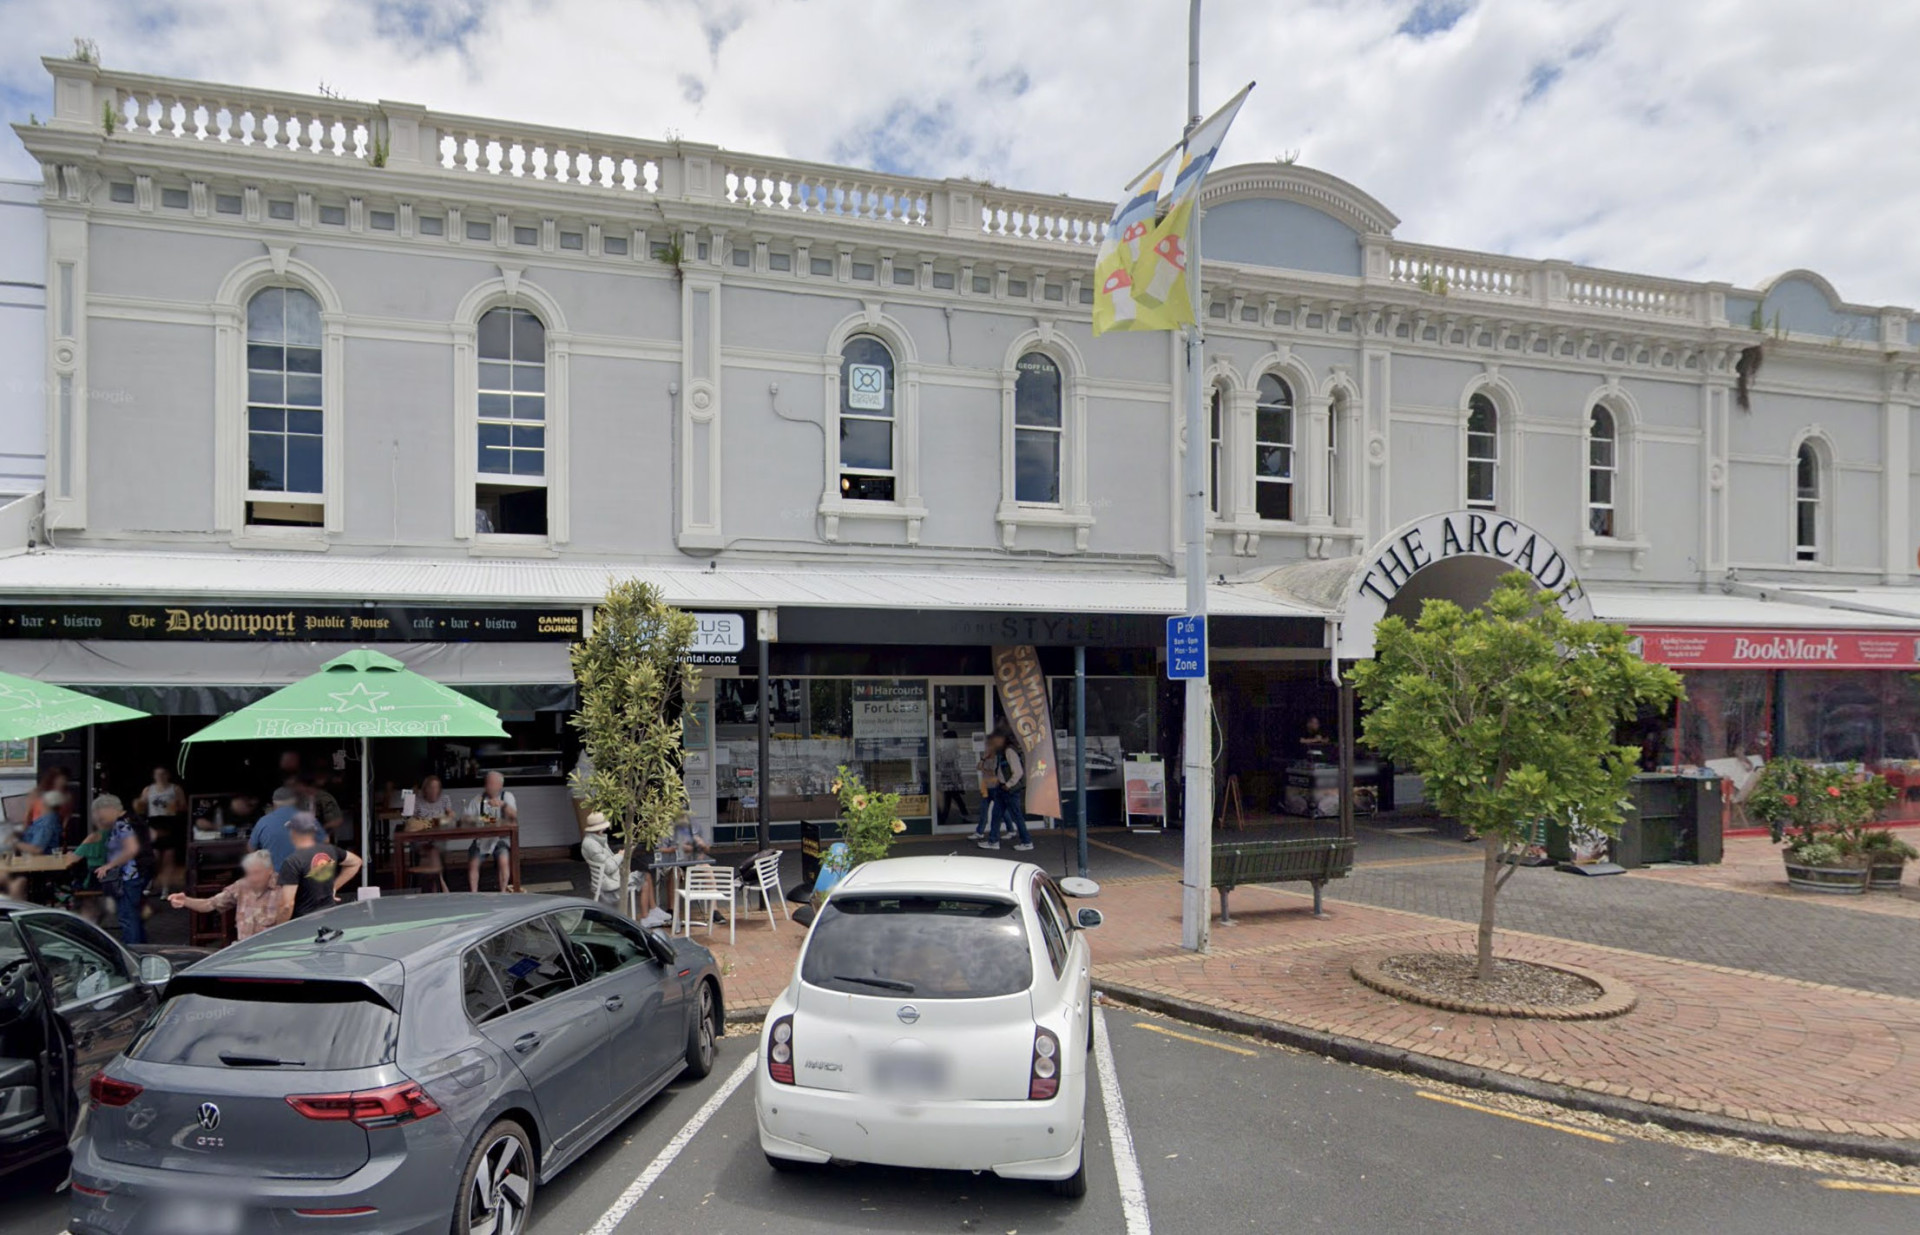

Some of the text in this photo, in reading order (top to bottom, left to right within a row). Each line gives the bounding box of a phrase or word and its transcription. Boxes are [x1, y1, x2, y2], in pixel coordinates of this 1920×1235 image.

[1017, 362, 1041, 370] GEOFF
[1358, 527, 1432, 604] THE
[21, 609, 517, 635] bar bistro The Devonport Public House cafe bar bistro
[538, 616, 578, 625] GAMING
[538, 625, 577, 633] LOUNGE
[1001, 616, 1104, 641] STYLE
[1177, 621, 1184, 634] P
[1174, 647, 1185, 655] Mon
[1188, 646, 1199, 654] Sun
[1732, 637, 1838, 660] BookMark
[1175, 658, 1198, 671] Zone
[874, 686, 924, 696] Harcourts
[864, 702, 920, 714] For Lease
[995, 653, 1041, 752] LOUNGE
[256, 716, 450, 737] Heineken
[196, 1136, 224, 1147] GTI
